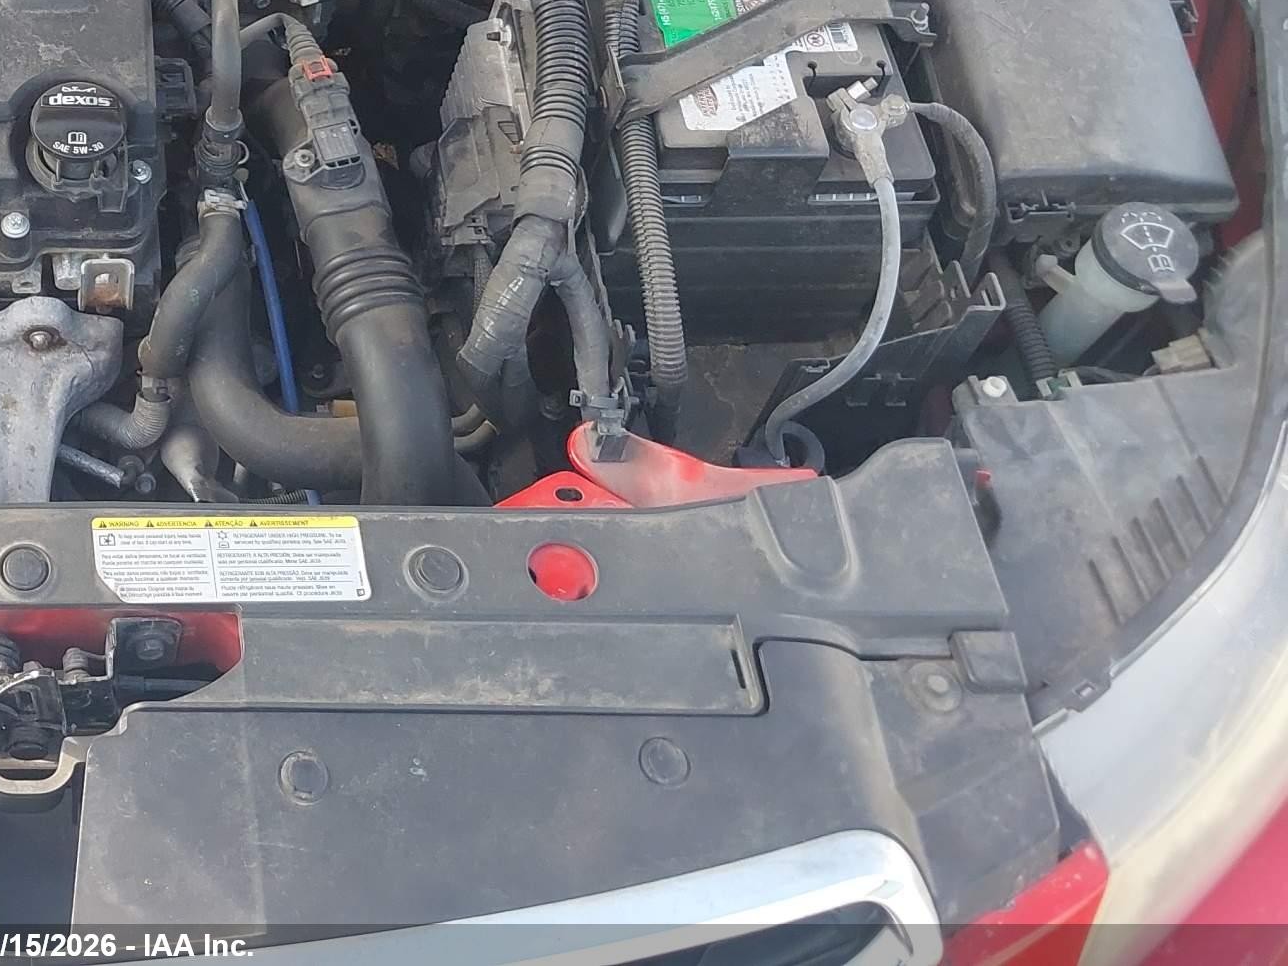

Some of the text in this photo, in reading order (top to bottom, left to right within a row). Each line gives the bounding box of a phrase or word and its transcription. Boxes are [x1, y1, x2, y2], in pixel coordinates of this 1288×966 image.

[48, 93, 112, 106] dexos
[52, 141, 104, 154] SAE 5W-30
